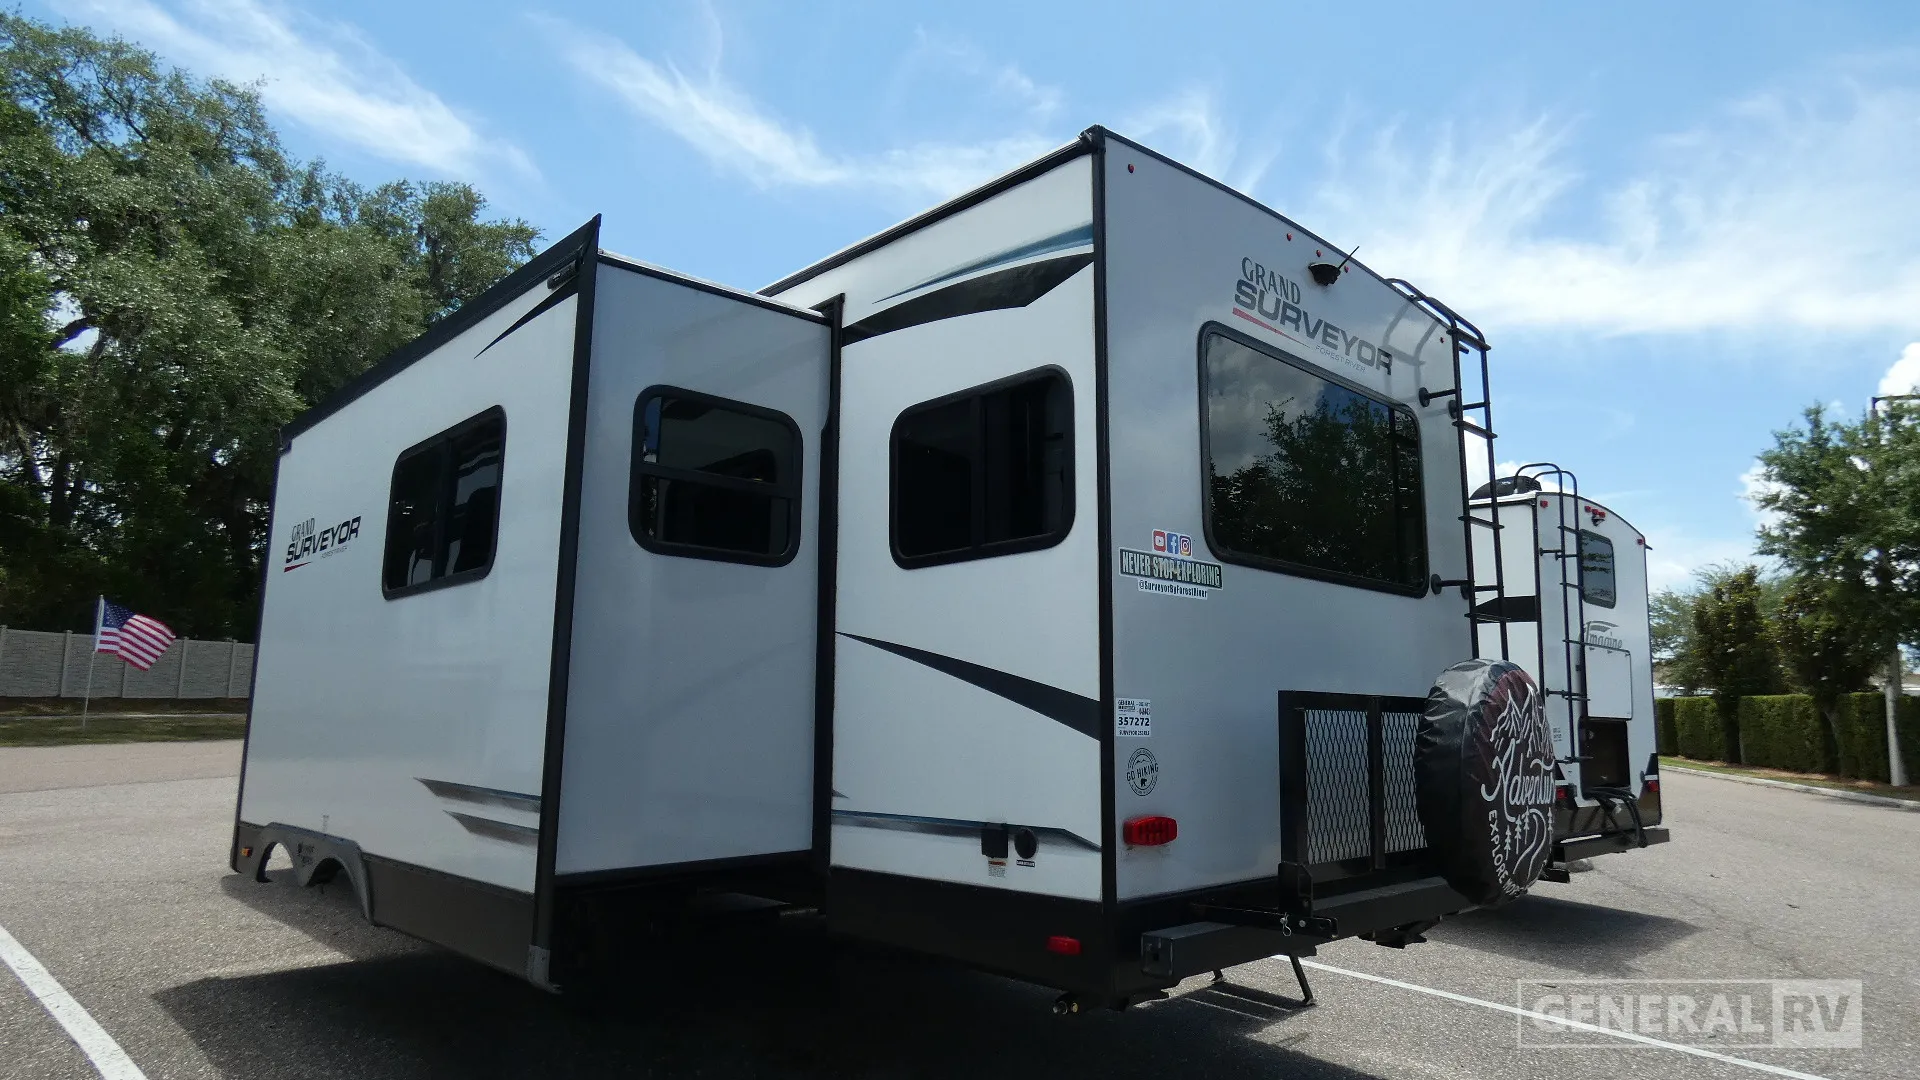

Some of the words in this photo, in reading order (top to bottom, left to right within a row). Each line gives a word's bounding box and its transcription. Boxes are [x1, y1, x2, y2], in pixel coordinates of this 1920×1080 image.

[1241, 256, 1301, 305] GRAND
[1234, 279, 1393, 376] SURVEYOR
[1315, 344, 1345, 364] FOREST
[1344, 358, 1367, 374] RIVER
[285, 515, 362, 564] SURVEYOR
[291, 517, 315, 542] GRAND
[1122, 551, 1151, 576] NEVER
[1152, 556, 1175, 580] STOP
[1176, 560, 1220, 588] EXPLORING
[1118, 716, 1150, 727] 357272
[1126, 770, 1136, 782] GO
[1136, 762, 1159, 779] HIKING
[1488, 809, 1509, 884] EXPLORE
